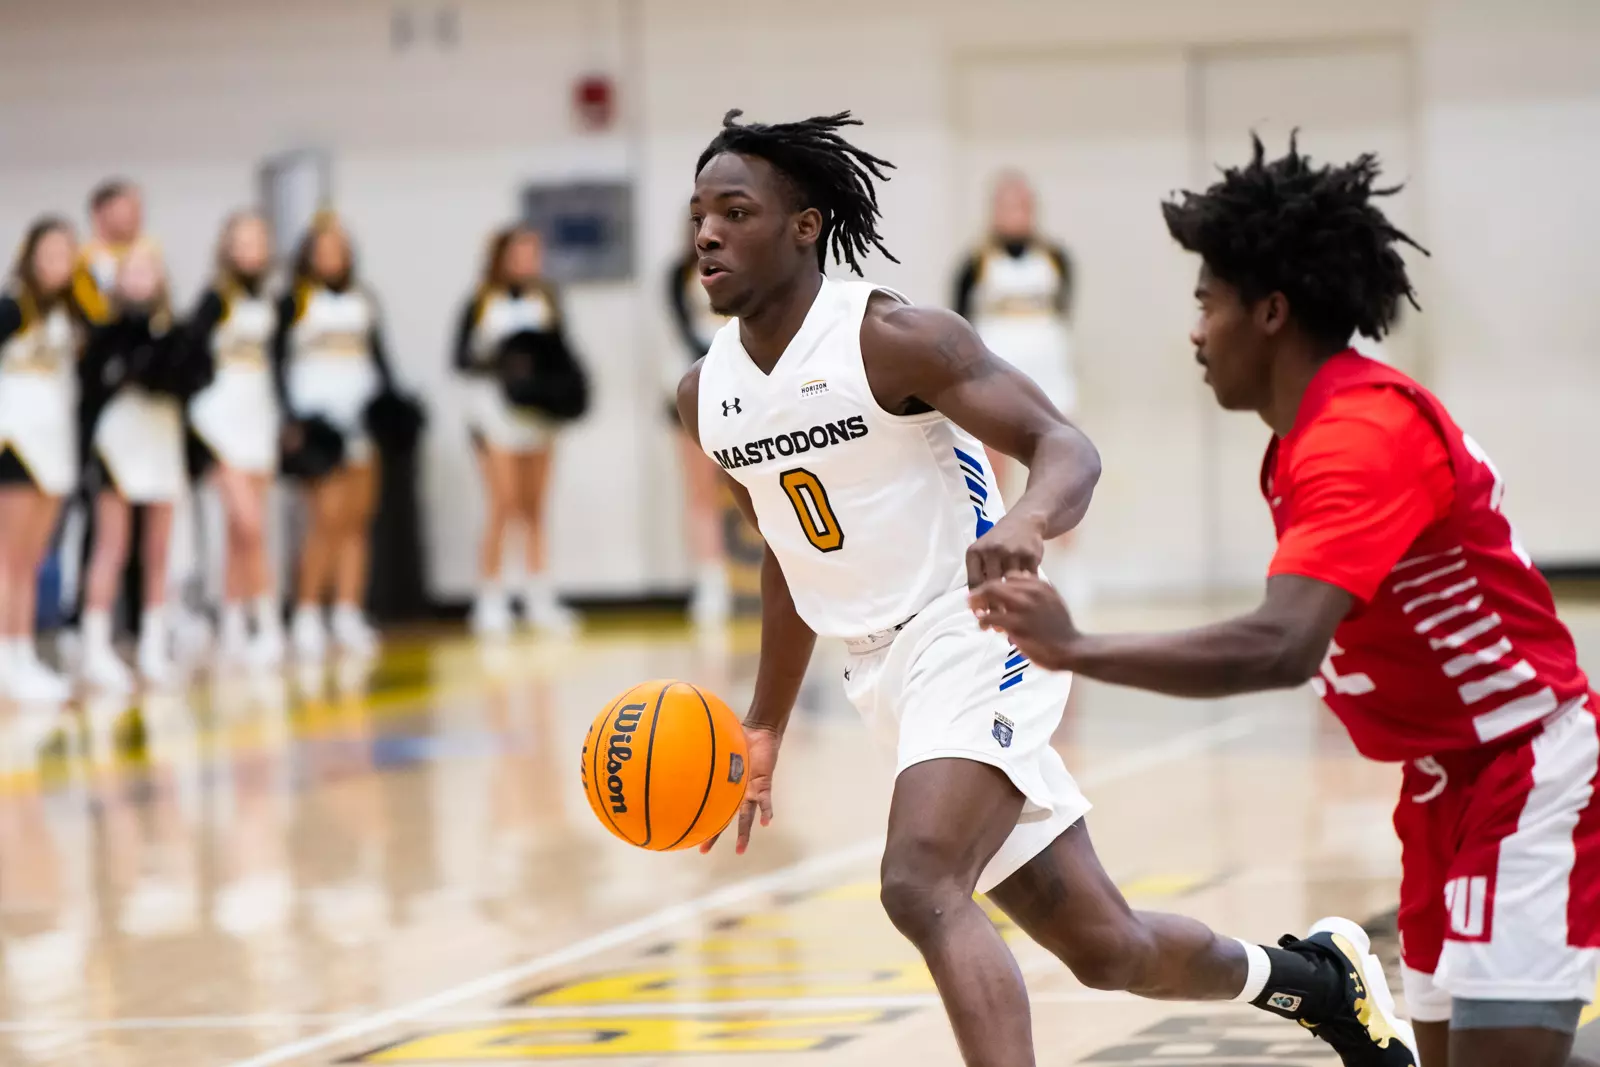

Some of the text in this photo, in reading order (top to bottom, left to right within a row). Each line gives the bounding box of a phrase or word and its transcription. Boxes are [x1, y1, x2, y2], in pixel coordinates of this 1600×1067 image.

[801, 382, 827, 394] HORIZON
[713, 415, 869, 470] MASTODONS
[779, 467, 845, 553] 0
[606, 702, 647, 814] Wilson
